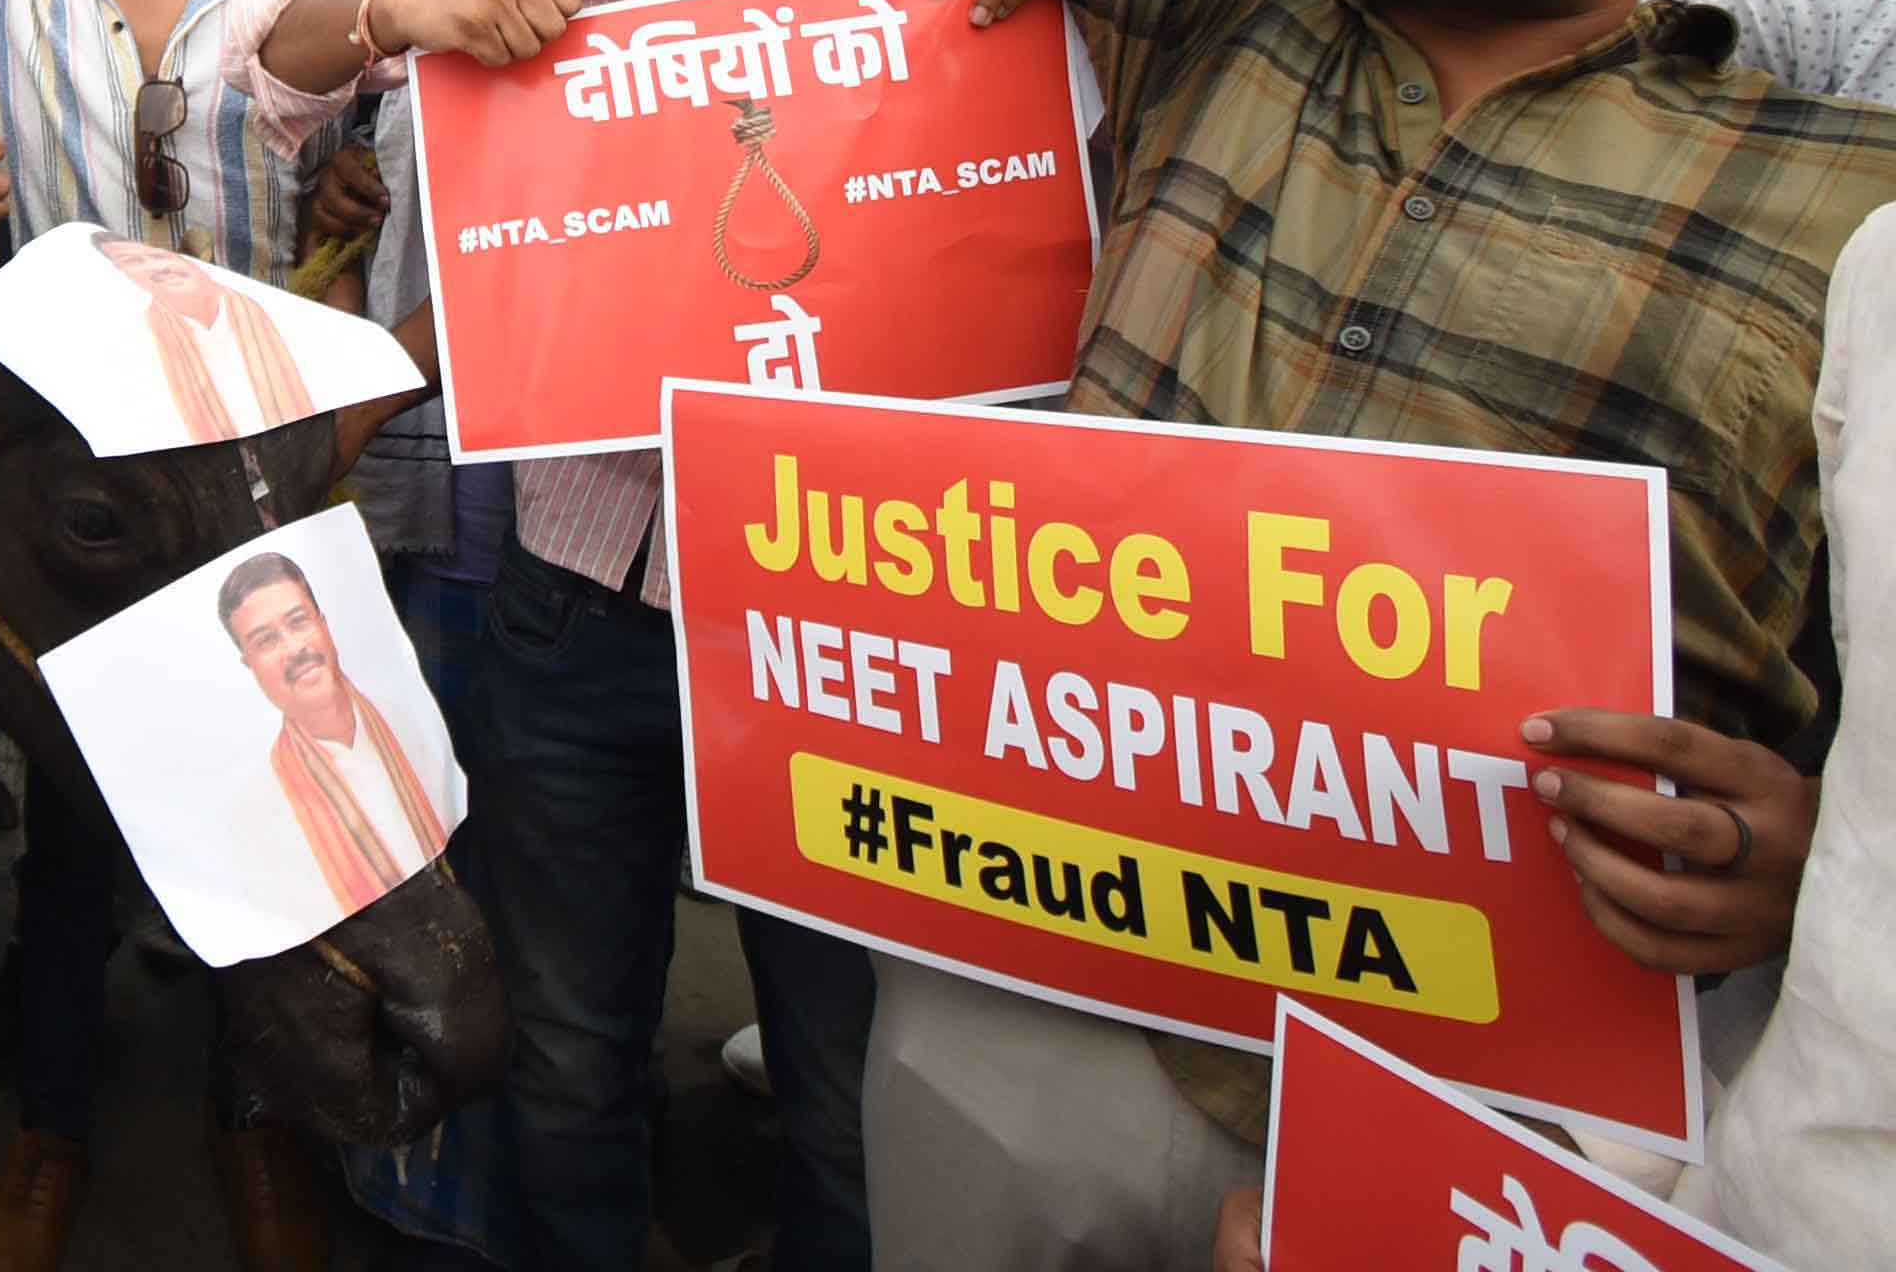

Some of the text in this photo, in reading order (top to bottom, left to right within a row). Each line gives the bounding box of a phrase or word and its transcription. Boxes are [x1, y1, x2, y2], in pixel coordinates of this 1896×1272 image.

[554, 5, 795, 122] दोषियों
[458, 199, 671, 254] #NTA_SCAM
[844, 150, 1056, 204] #NTA_SCAM
[745, 455, 1513, 691] Justice For
[745, 610, 1529, 863] NEET ASPIRANT
[841, 783, 1418, 994] #Fraud NTA
